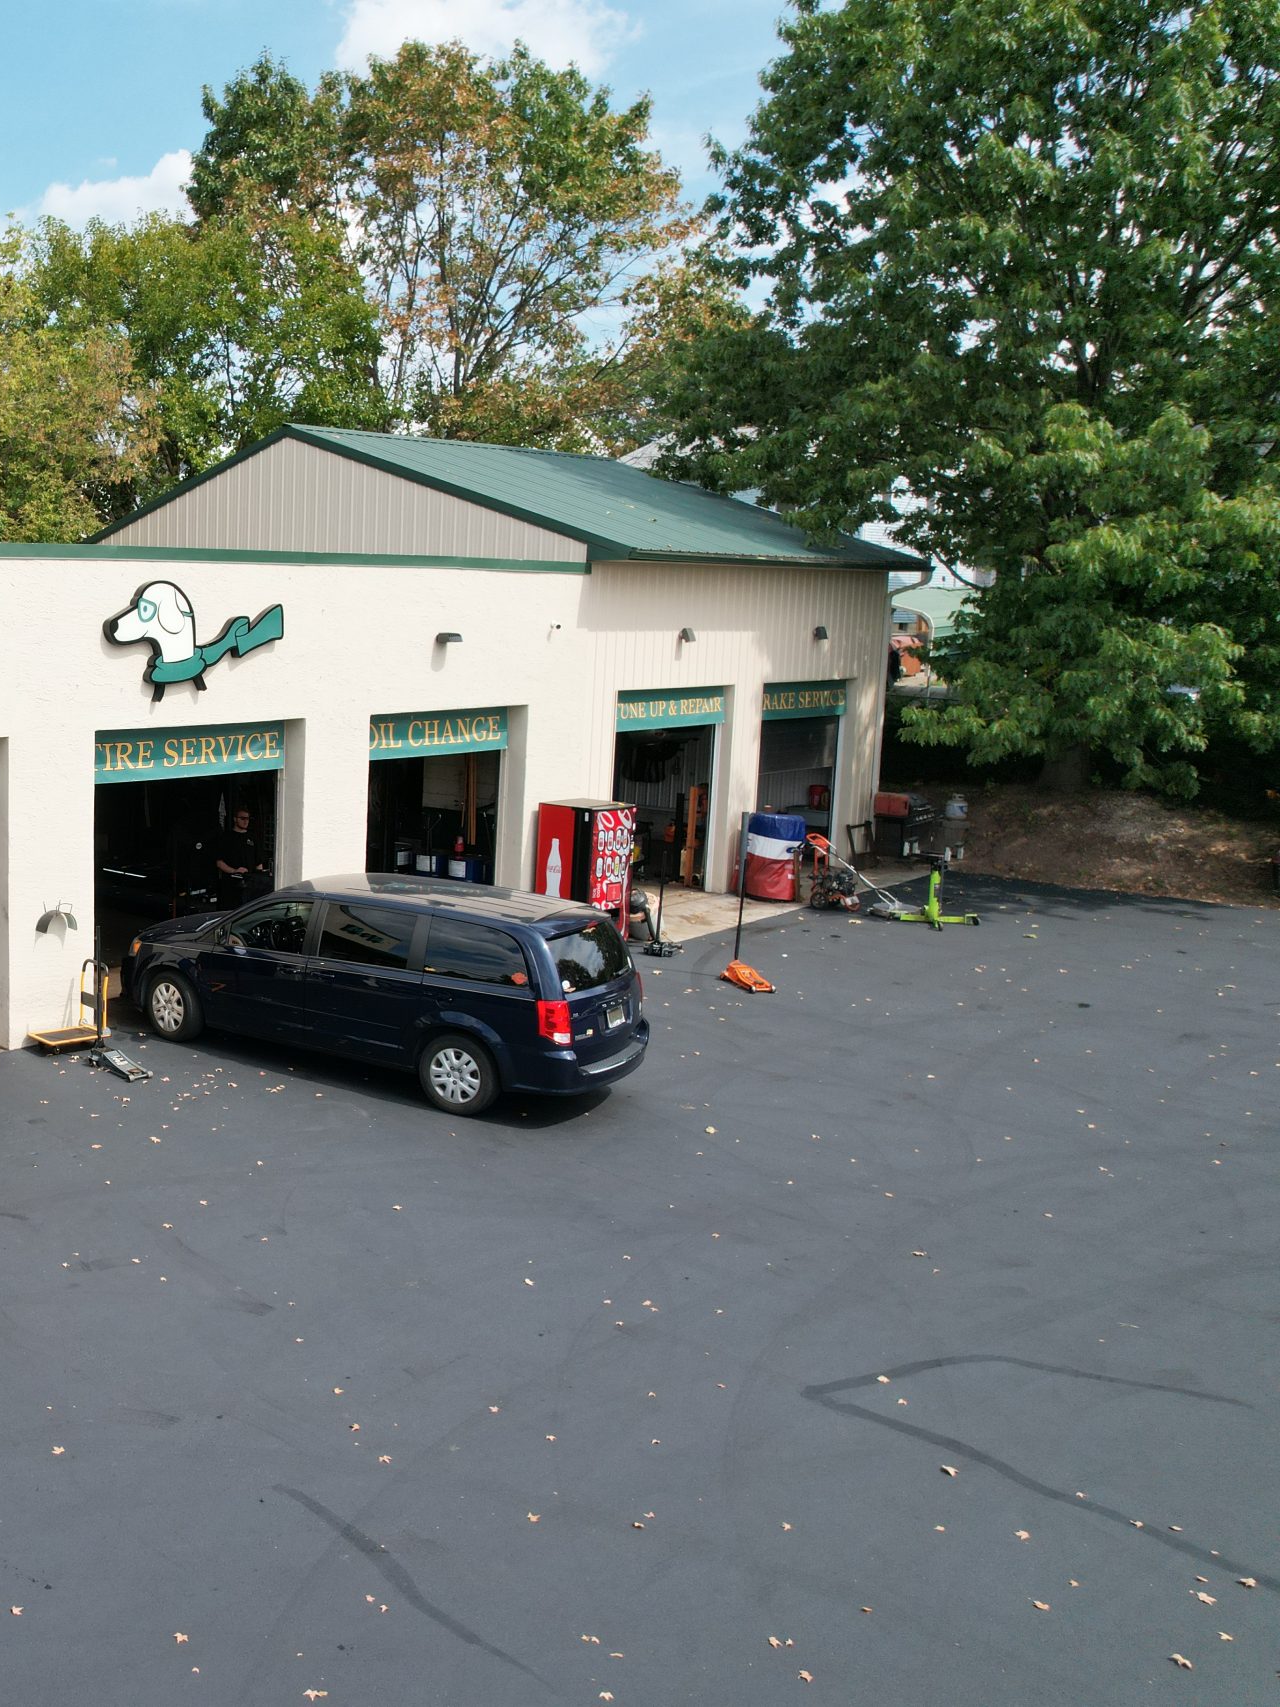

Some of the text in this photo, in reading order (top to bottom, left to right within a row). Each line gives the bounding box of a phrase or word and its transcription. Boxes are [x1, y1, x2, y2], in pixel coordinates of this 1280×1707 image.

[649, 700, 666, 717] UP
[668, 699, 677, 716] &
[680, 696, 722, 715] REPAIR
[798, 688, 845, 708] SERVICE
[408, 715, 501, 747] CHANGE
[163, 731, 280, 768] SERVICE
